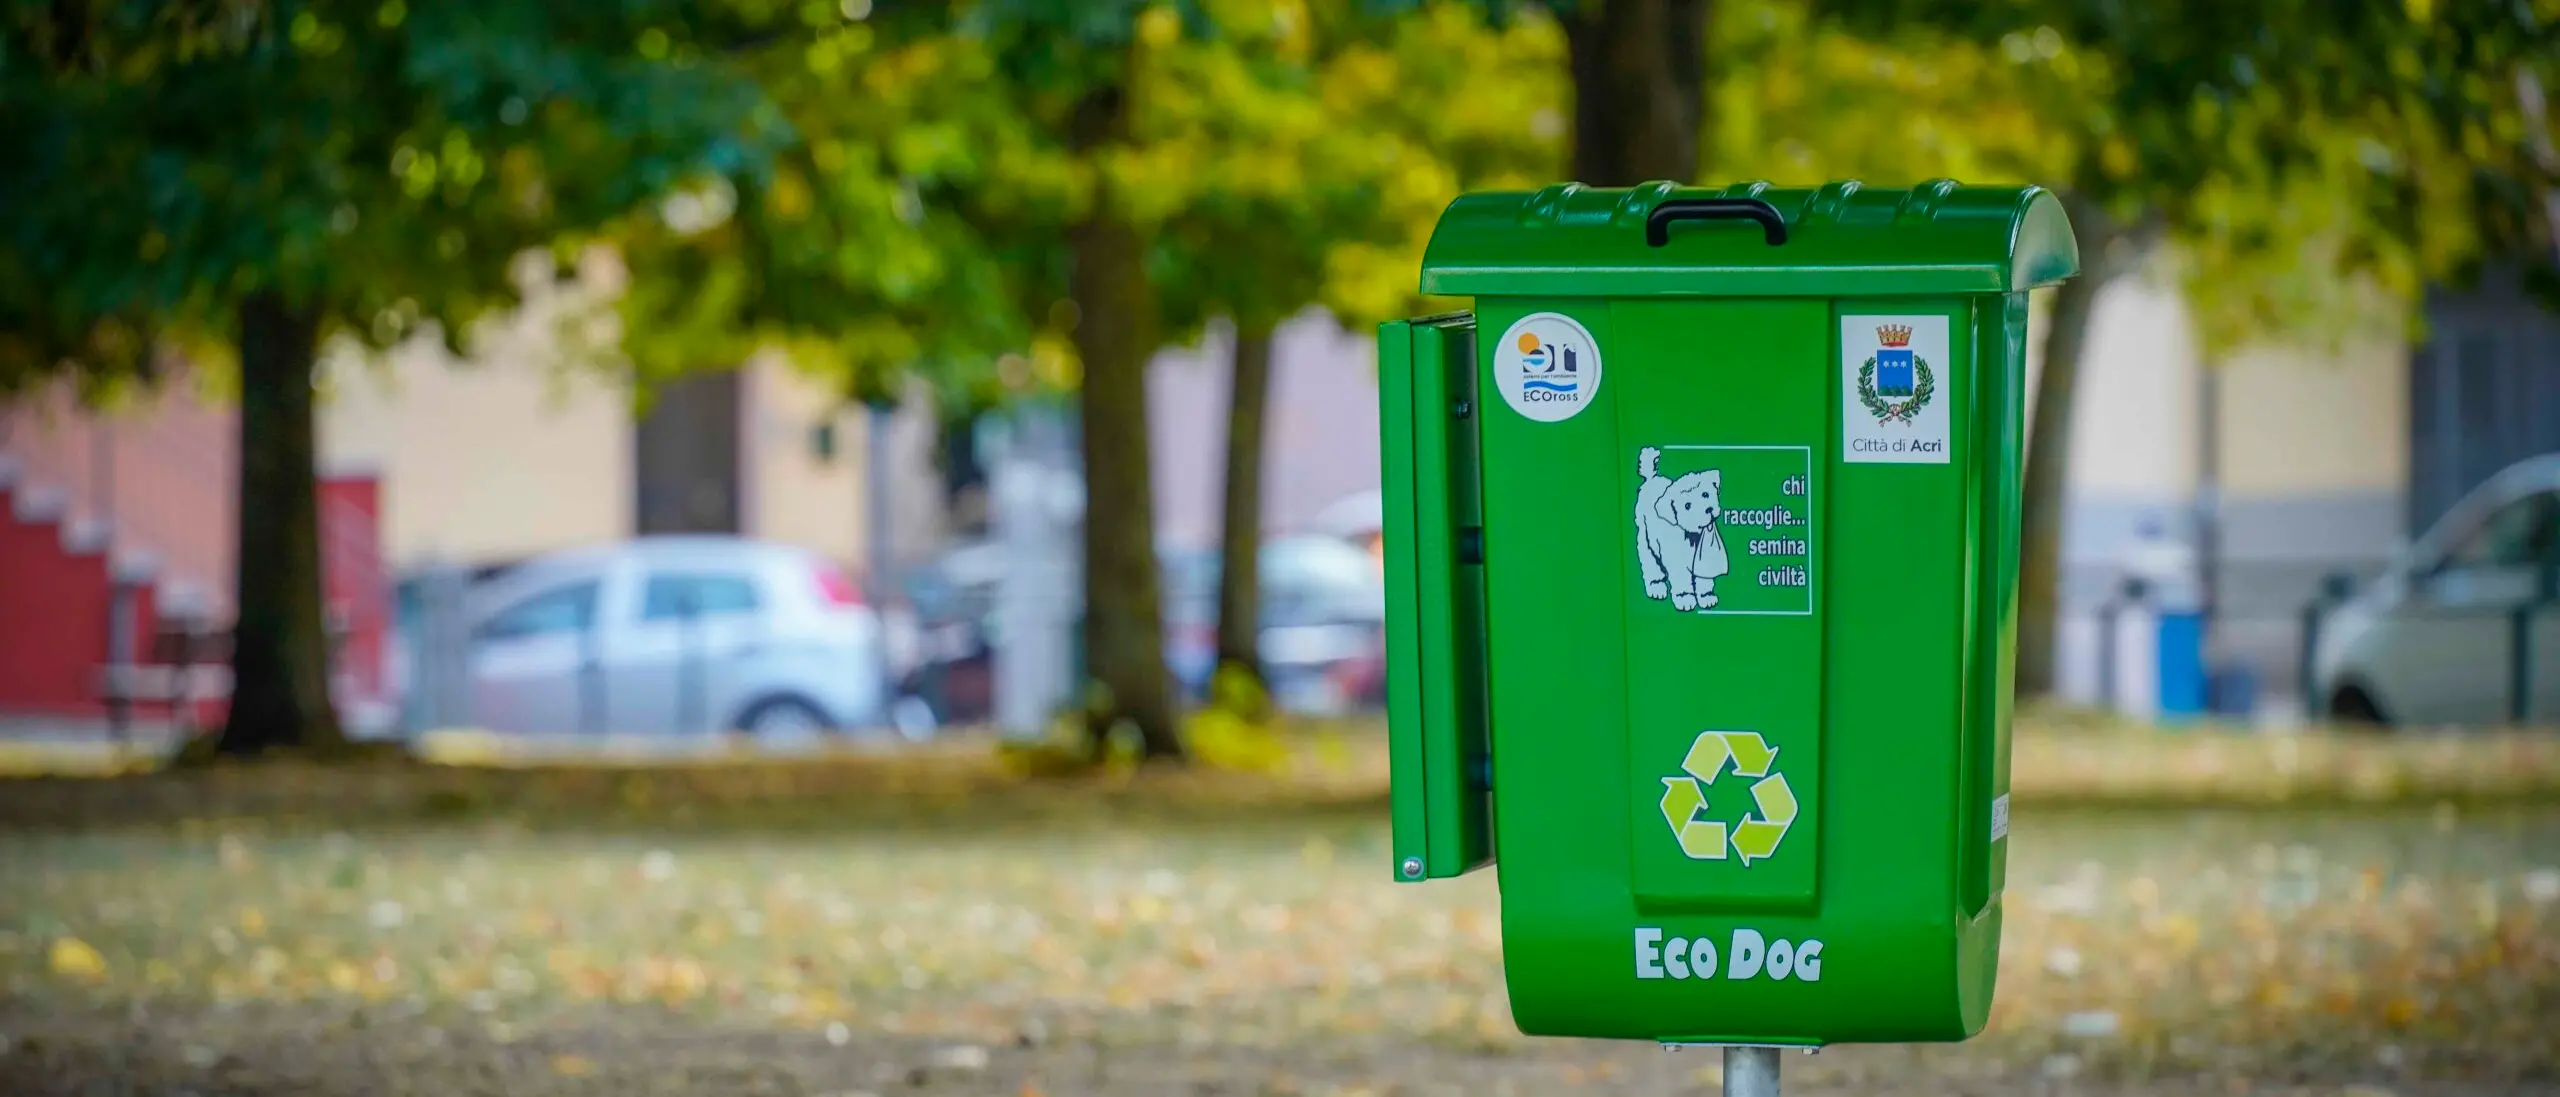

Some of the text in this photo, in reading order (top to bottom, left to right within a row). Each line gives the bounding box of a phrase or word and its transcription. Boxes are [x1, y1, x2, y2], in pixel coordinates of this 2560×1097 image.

[1852, 438, 1942, 452] Città di Acri
[1782, 475, 1805, 495] chi
[1723, 505, 1806, 530] raccoglie...
[1749, 536, 1806, 555] semina
[1758, 565, 1806, 587] civiltà
